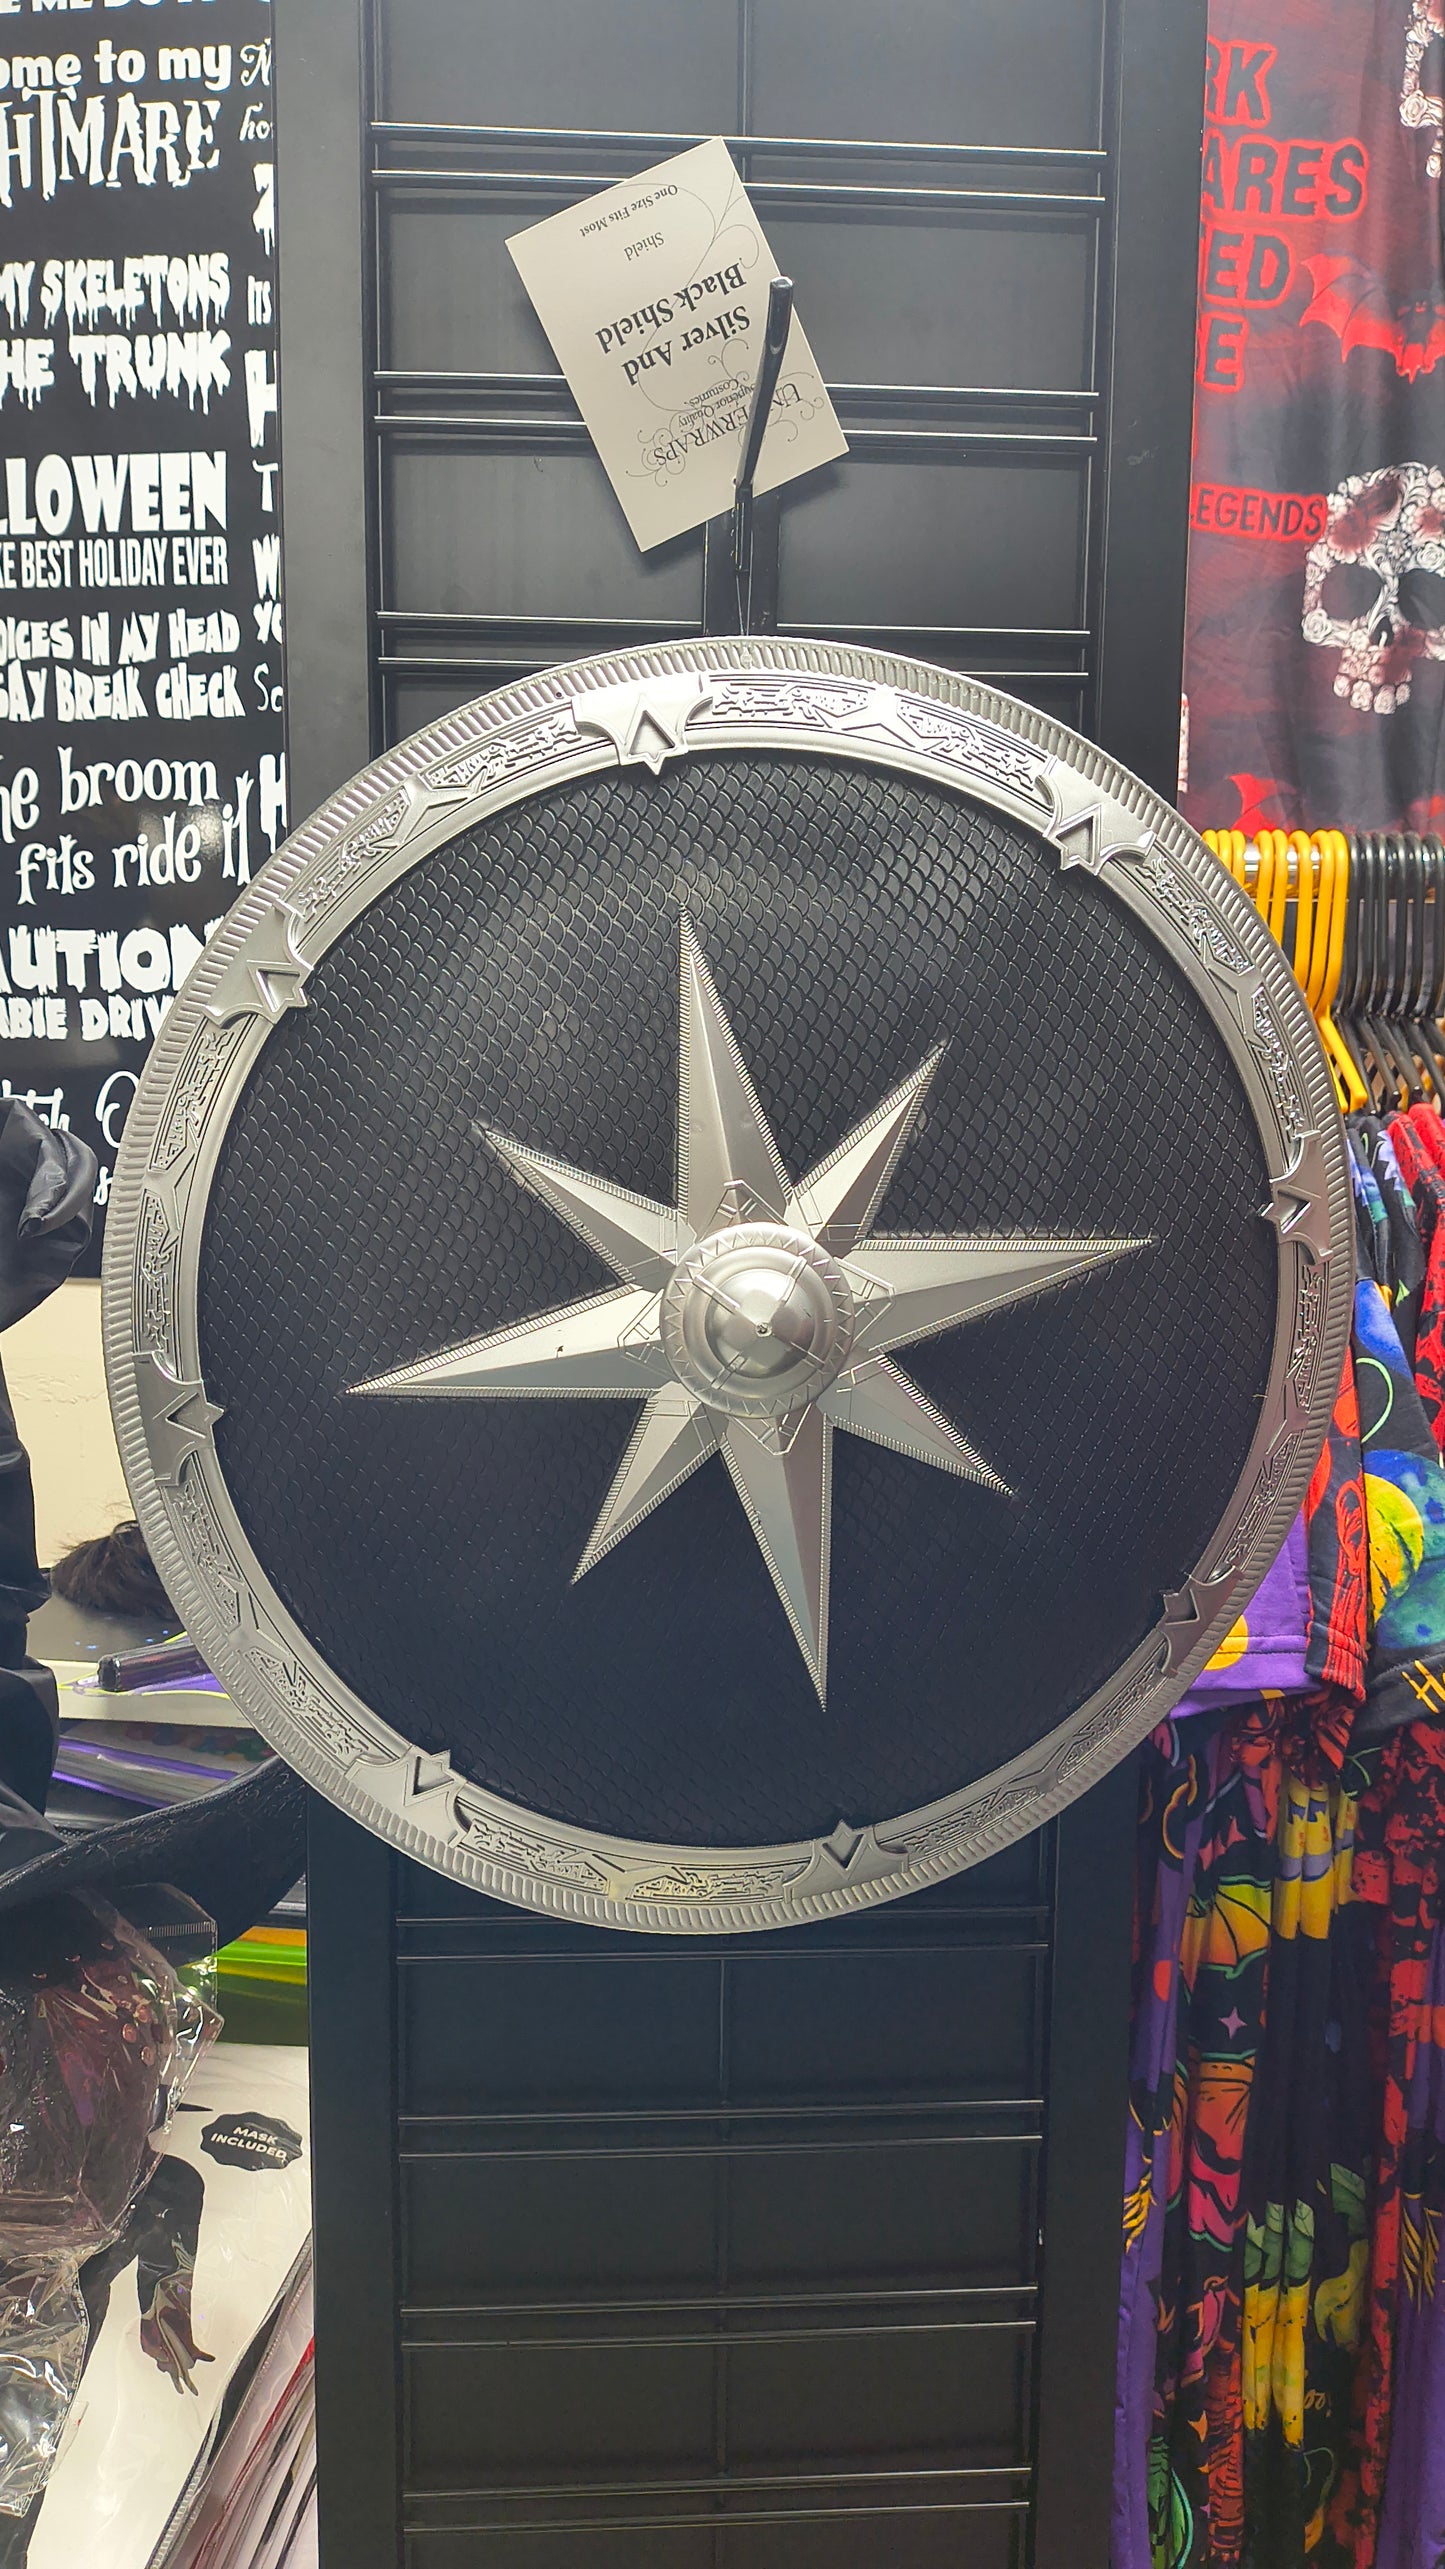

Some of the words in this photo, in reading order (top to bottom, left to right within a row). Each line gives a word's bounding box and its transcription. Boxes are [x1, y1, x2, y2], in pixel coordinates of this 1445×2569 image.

[94, 39, 146, 84] to
[158, 45, 232, 91] my
[608, 206, 631, 222] Fits
[630, 195, 654, 211] Size
[654, 184, 679, 200] One
[579, 217, 608, 237] Most
[624, 231, 665, 261] Shield
[673, 262, 747, 312] Black
[1200, 223, 1290, 301] ED
[40, 251, 231, 334] SKELETONS
[594, 298, 674, 354] Shield
[680, 305, 751, 351] Silver
[69, 328, 232, 417] TRUNK
[621, 340, 673, 386] And
[653, 382, 803, 466] UNERWRAPS
[677, 404, 715, 428] Quality
[0, 450, 228, 536] LOWEEN
[1190, 487, 1323, 537] EGENDS
[20, 540, 74, 589] BEST
[79, 537, 168, 587] HOLIDAY
[171, 535, 229, 586] EVER
[81, 611, 111, 666] IN
[118, 611, 160, 665] MY
[168, 608, 241, 659] HEAD
[55, 664, 149, 722] BREAK
[155, 662, 246, 721] CHECK
[57, 745, 220, 815] broom
[15, 833, 96, 906] fits
[111, 811, 202, 888] ride
[222, 770, 255, 886] it
[211, 2133, 287, 2160] INCLUDED
[233, 2126, 278, 2145] MASK
